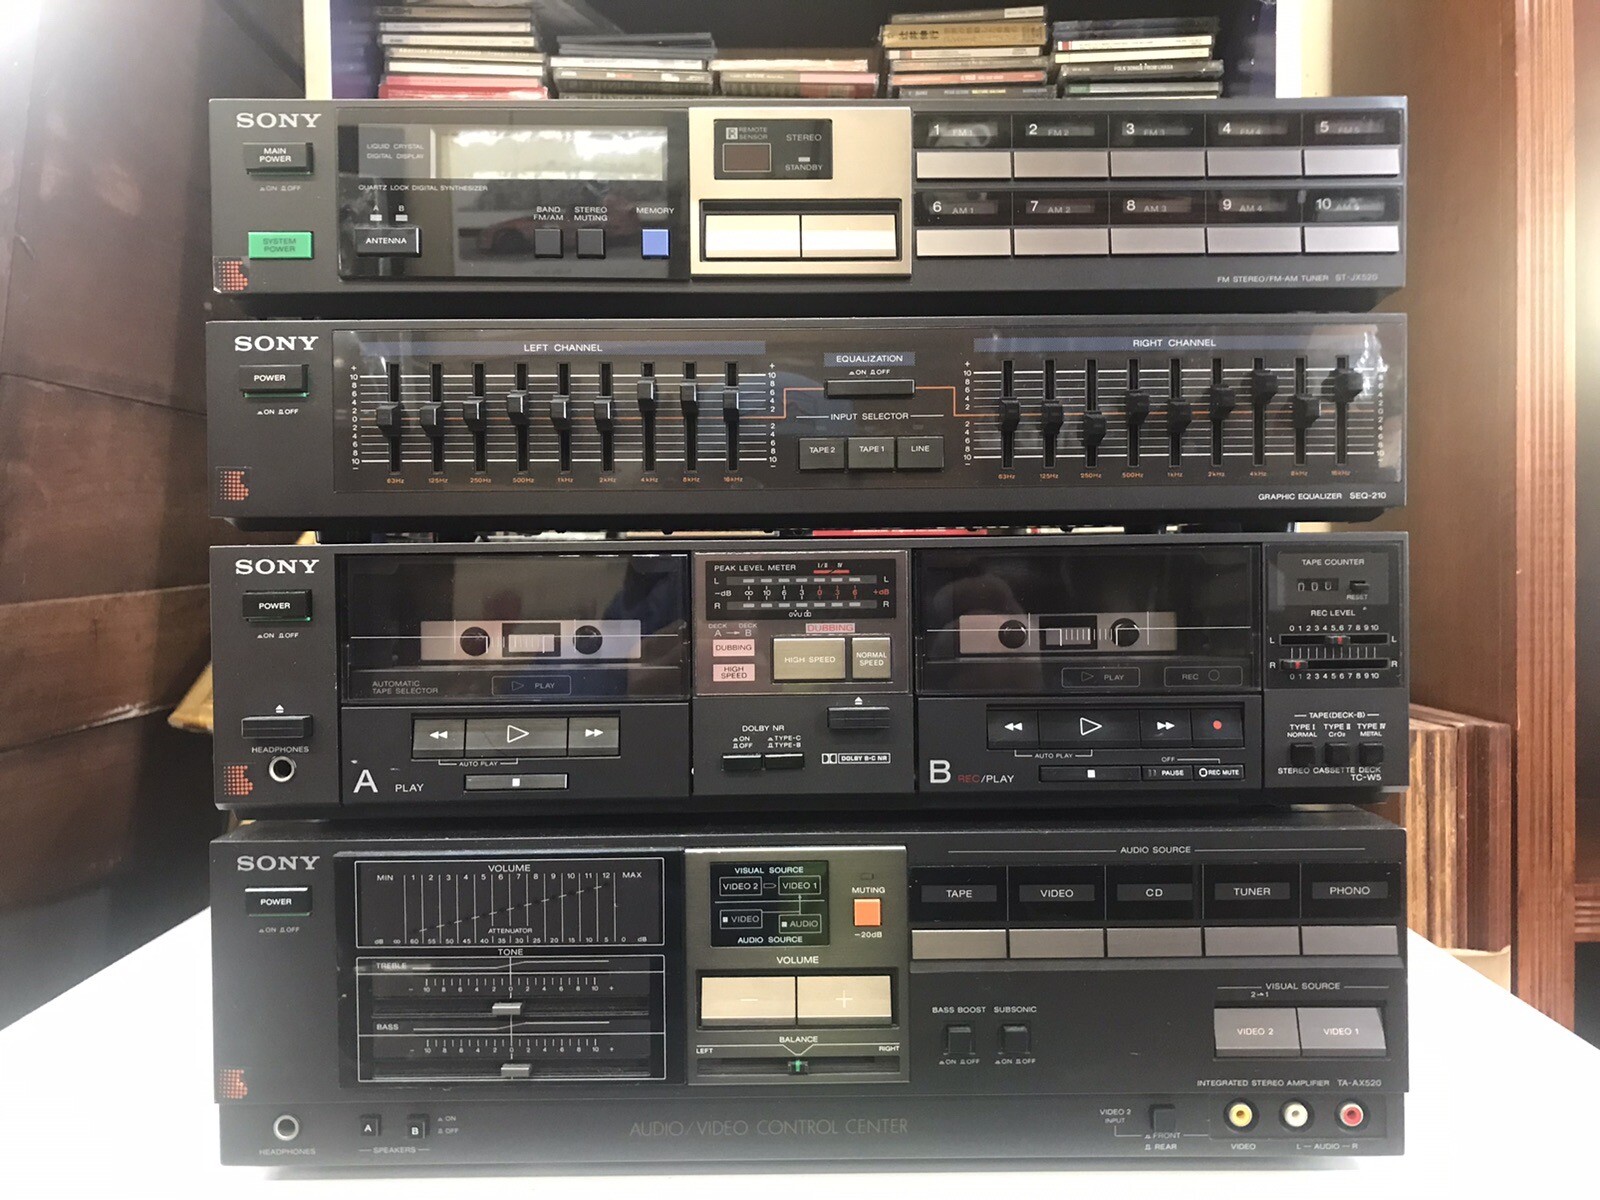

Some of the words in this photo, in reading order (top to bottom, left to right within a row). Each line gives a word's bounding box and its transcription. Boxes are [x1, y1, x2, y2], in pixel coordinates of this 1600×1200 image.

[236, 112, 322, 128] SONY
[932, 124, 941, 135] 1
[1028, 124, 1038, 135] 2
[1126, 123, 1135, 135] 3
[1222, 122, 1231, 134] 4
[1320, 121, 1329, 133] 5
[263, 147, 287, 155] MAIN
[259, 155, 292, 163] POWER
[932, 201, 942, 213] 6
[1030, 200, 1039, 212] 7
[1126, 200, 1136, 211] 8
[1222, 199, 1232, 210] 9
[1316, 198, 1332, 210] 10
[573, 214, 608, 222] MUTING
[365, 237, 407, 245] ANTENNA
[1233, 275, 1299, 283] STEREO/FM-AM
[234, 335, 319, 351] SONY
[1133, 339, 1162, 347] RIGHT
[1168, 339, 1216, 347] CHANNEL
[524, 344, 548, 352] LEFT
[554, 344, 603, 352] CHANNEL
[836, 355, 903, 363] EQUALIZATION
[253, 374, 286, 382] POWER
[830, 413, 858, 421] INPUT
[861, 412, 909, 420] SELECTOR
[809, 446, 829, 454] TAPE
[859, 445, 880, 453] TAPE
[910, 445, 930, 453] LINE
[1258, 492, 1295, 501] GRAPHIC
[1298, 492, 1342, 500] EQUALIZER
[1349, 491, 1387, 500] SEQ-210
[1301, 558, 1322, 566] TAPE
[1324, 558, 1365, 566] COUNTER
[235, 558, 320, 575] SONY
[714, 564, 736, 572] PEAK
[739, 564, 765, 572] LEVEL
[767, 563, 796, 571] METER
[258, 602, 291, 610] POWER
[807, 624, 854, 632] DUBBING
[784, 656, 807, 664] HIGH
[809, 656, 836, 664] SPEED
[859, 659, 885, 667] SPEED
[1103, 673, 1125, 681] PLAY
[1181, 673, 1199, 681] REC
[372, 680, 420, 688] AUTOMATIC
[534, 682, 555, 690] PLAY
[372, 687, 393, 695] TAPE
[395, 687, 439, 695] SELECTOR
[1290, 723, 1311, 731] TYPE
[1357, 722, 1378, 730] TYPE
[251, 745, 310, 754] HEADPHONES
[929, 759, 951, 784] B
[1313, 766, 1355, 774] CASSETTE
[353, 769, 378, 793] A
[957, 773, 1015, 784] REC/PLAY
[1351, 773, 1382, 781] TC-W5
[395, 783, 424, 792] PLAY
[1120, 846, 1149, 854] AUDIO
[1152, 846, 1191, 854] SOURCE
[236, 855, 320, 871] SONY
[488, 864, 531, 873] VOLUME
[769, 866, 804, 874] SOURCE
[722, 882, 751, 890] VIDEO
[851, 886, 885, 894] MUTING
[946, 889, 972, 898] TAPE
[1040, 889, 1074, 898] VIDEO
[1145, 888, 1163, 897] CD
[1233, 887, 1271, 896] TUNER
[1329, 886, 1371, 895] PHONO
[731, 915, 760, 923] VIDEO
[789, 920, 818, 928] AUDIO
[737, 936, 764, 944] AUDIO
[768, 936, 803, 944] SOURCE
[498, 948, 523, 956] TONE
[776, 956, 819, 964] VOLUME
[376, 962, 407, 970] TREBLE
[1265, 982, 1298, 990] VISUAL
[1301, 982, 1341, 990] SOURCE
[932, 1006, 955, 1014] BASS
[376, 1023, 399, 1031] BASS
[1236, 1028, 1265, 1036] VIDEO
[1323, 1028, 1352, 1036] VIDEO
[1197, 1079, 1249, 1087] INTEGRATED
[1251, 1079, 1285, 1087] STEREO
[1286, 1079, 1330, 1087] AMPLIFIER
[1337, 1079, 1382, 1087] TA-AX520
[1100, 1108, 1125, 1116] VIDEO
[629, 1119, 749, 1137] AUDIO/VIDEO
[756, 1119, 838, 1136] CONTROL
[845, 1118, 908, 1135] CENTER
[1153, 1131, 1181, 1139] FRONT
[259, 1148, 316, 1156] HEADPHONES
[373, 1146, 416, 1154] SPEAKERS
